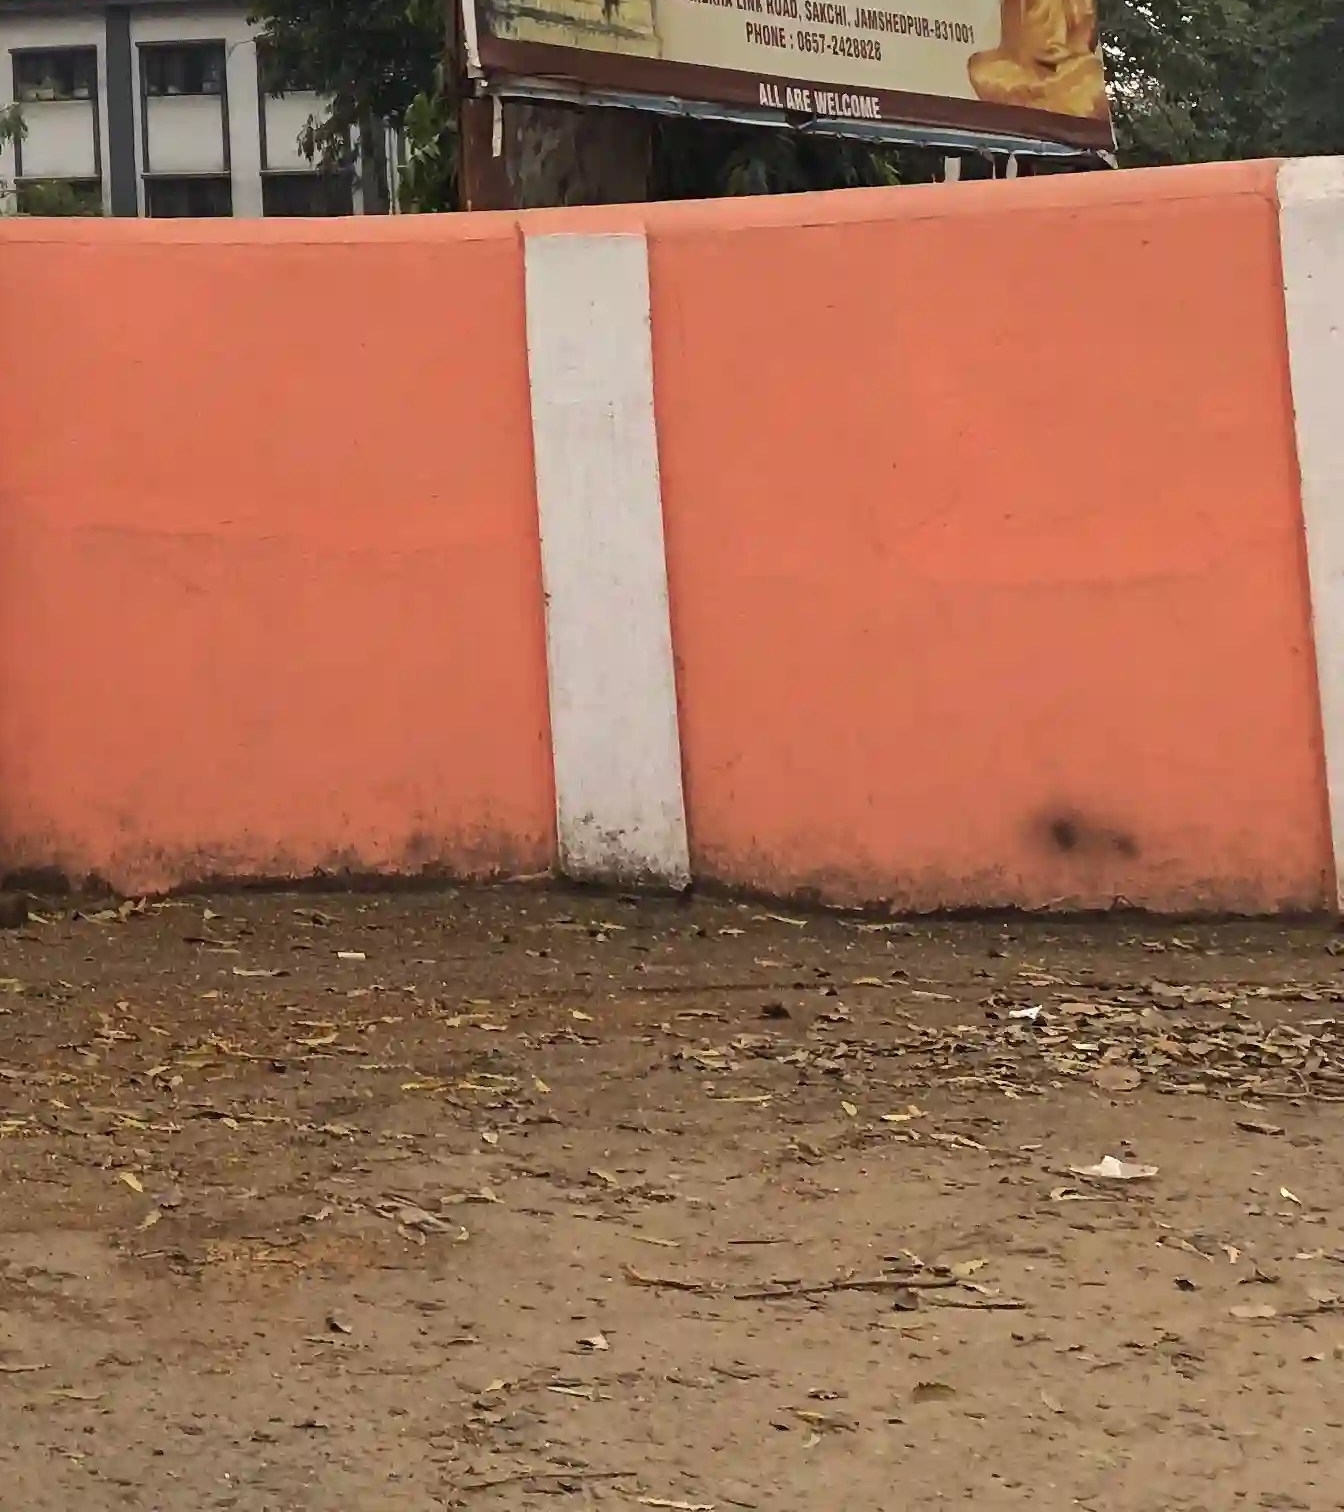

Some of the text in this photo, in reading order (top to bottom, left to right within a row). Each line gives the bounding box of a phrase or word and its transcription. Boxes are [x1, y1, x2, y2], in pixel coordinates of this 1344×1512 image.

[745, 21, 787, 49] PHONE
[759, 82, 882, 119] ALL ARE WELCOME
